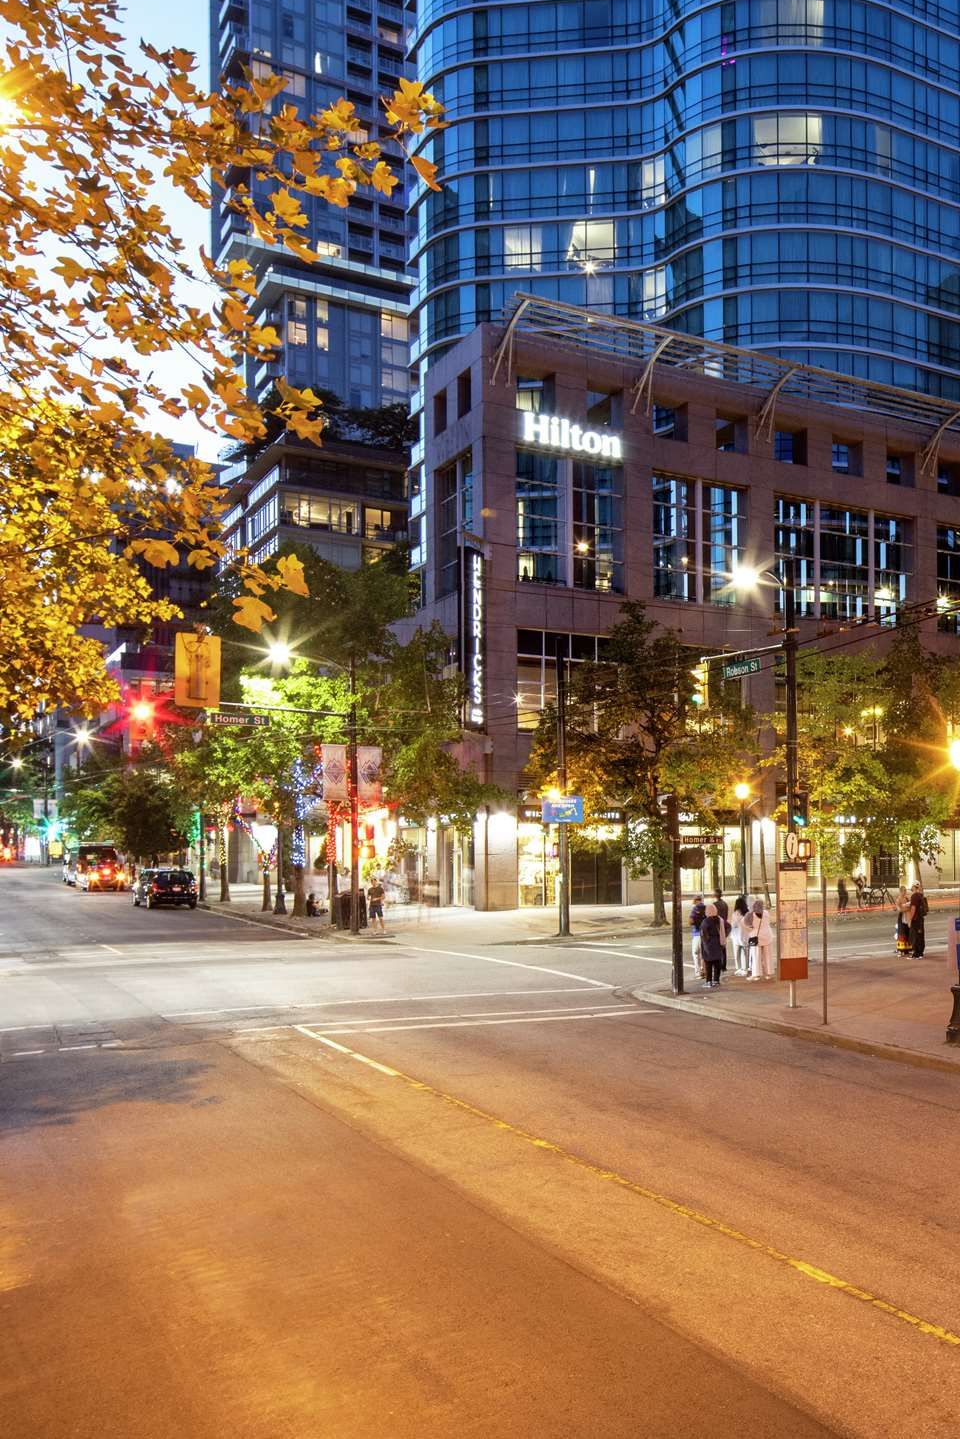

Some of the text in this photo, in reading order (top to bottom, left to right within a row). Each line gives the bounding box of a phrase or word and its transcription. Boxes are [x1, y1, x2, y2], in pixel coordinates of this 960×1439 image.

[523, 411, 622, 458] Hilton
[472, 554, 483, 704] HENDRICKS
[726, 661, 758, 677] Robson St
[215, 714, 265, 725] Homer St
